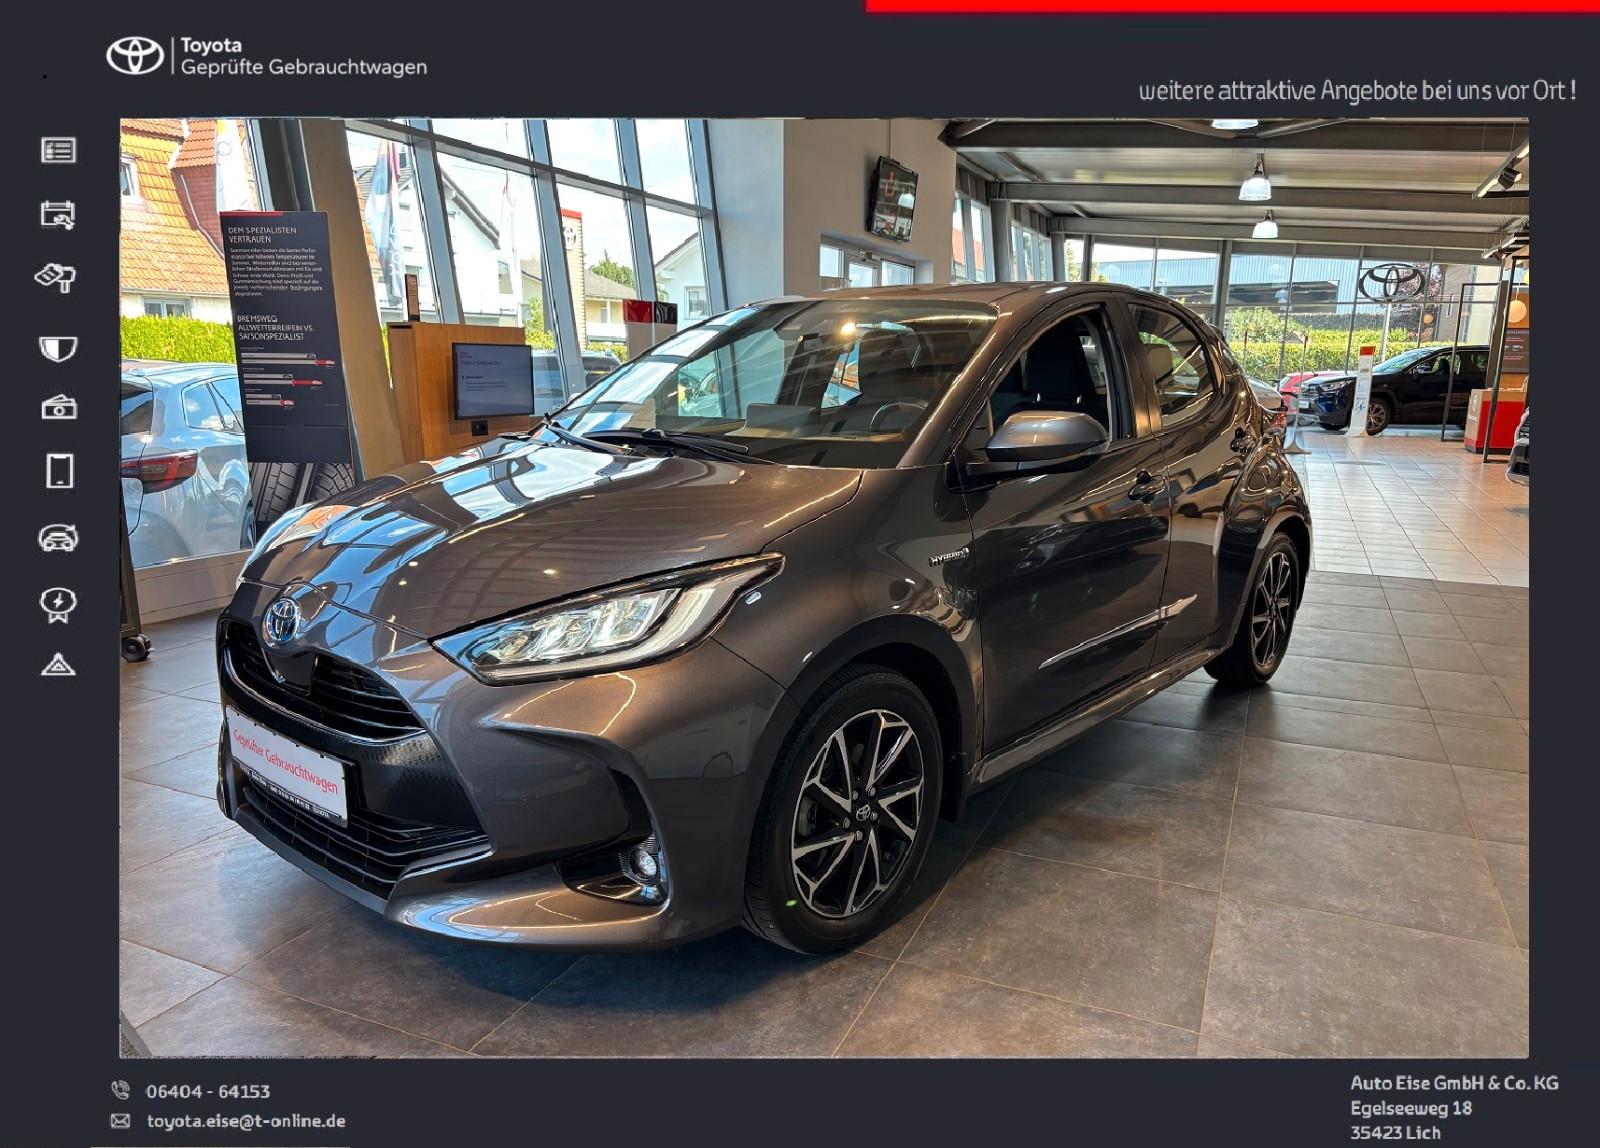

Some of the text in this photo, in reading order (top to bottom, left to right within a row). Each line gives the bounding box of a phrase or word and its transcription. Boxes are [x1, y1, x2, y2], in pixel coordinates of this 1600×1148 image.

[246, 226, 297, 234] SPEZIALISTEN
[228, 235, 272, 243] VERTRAUEN
[237, 314, 278, 323] BREMSWEG
[239, 332, 305, 341] SAISONSPEZIALIST
[265, 748, 338, 795] Gebrauchtwagen
